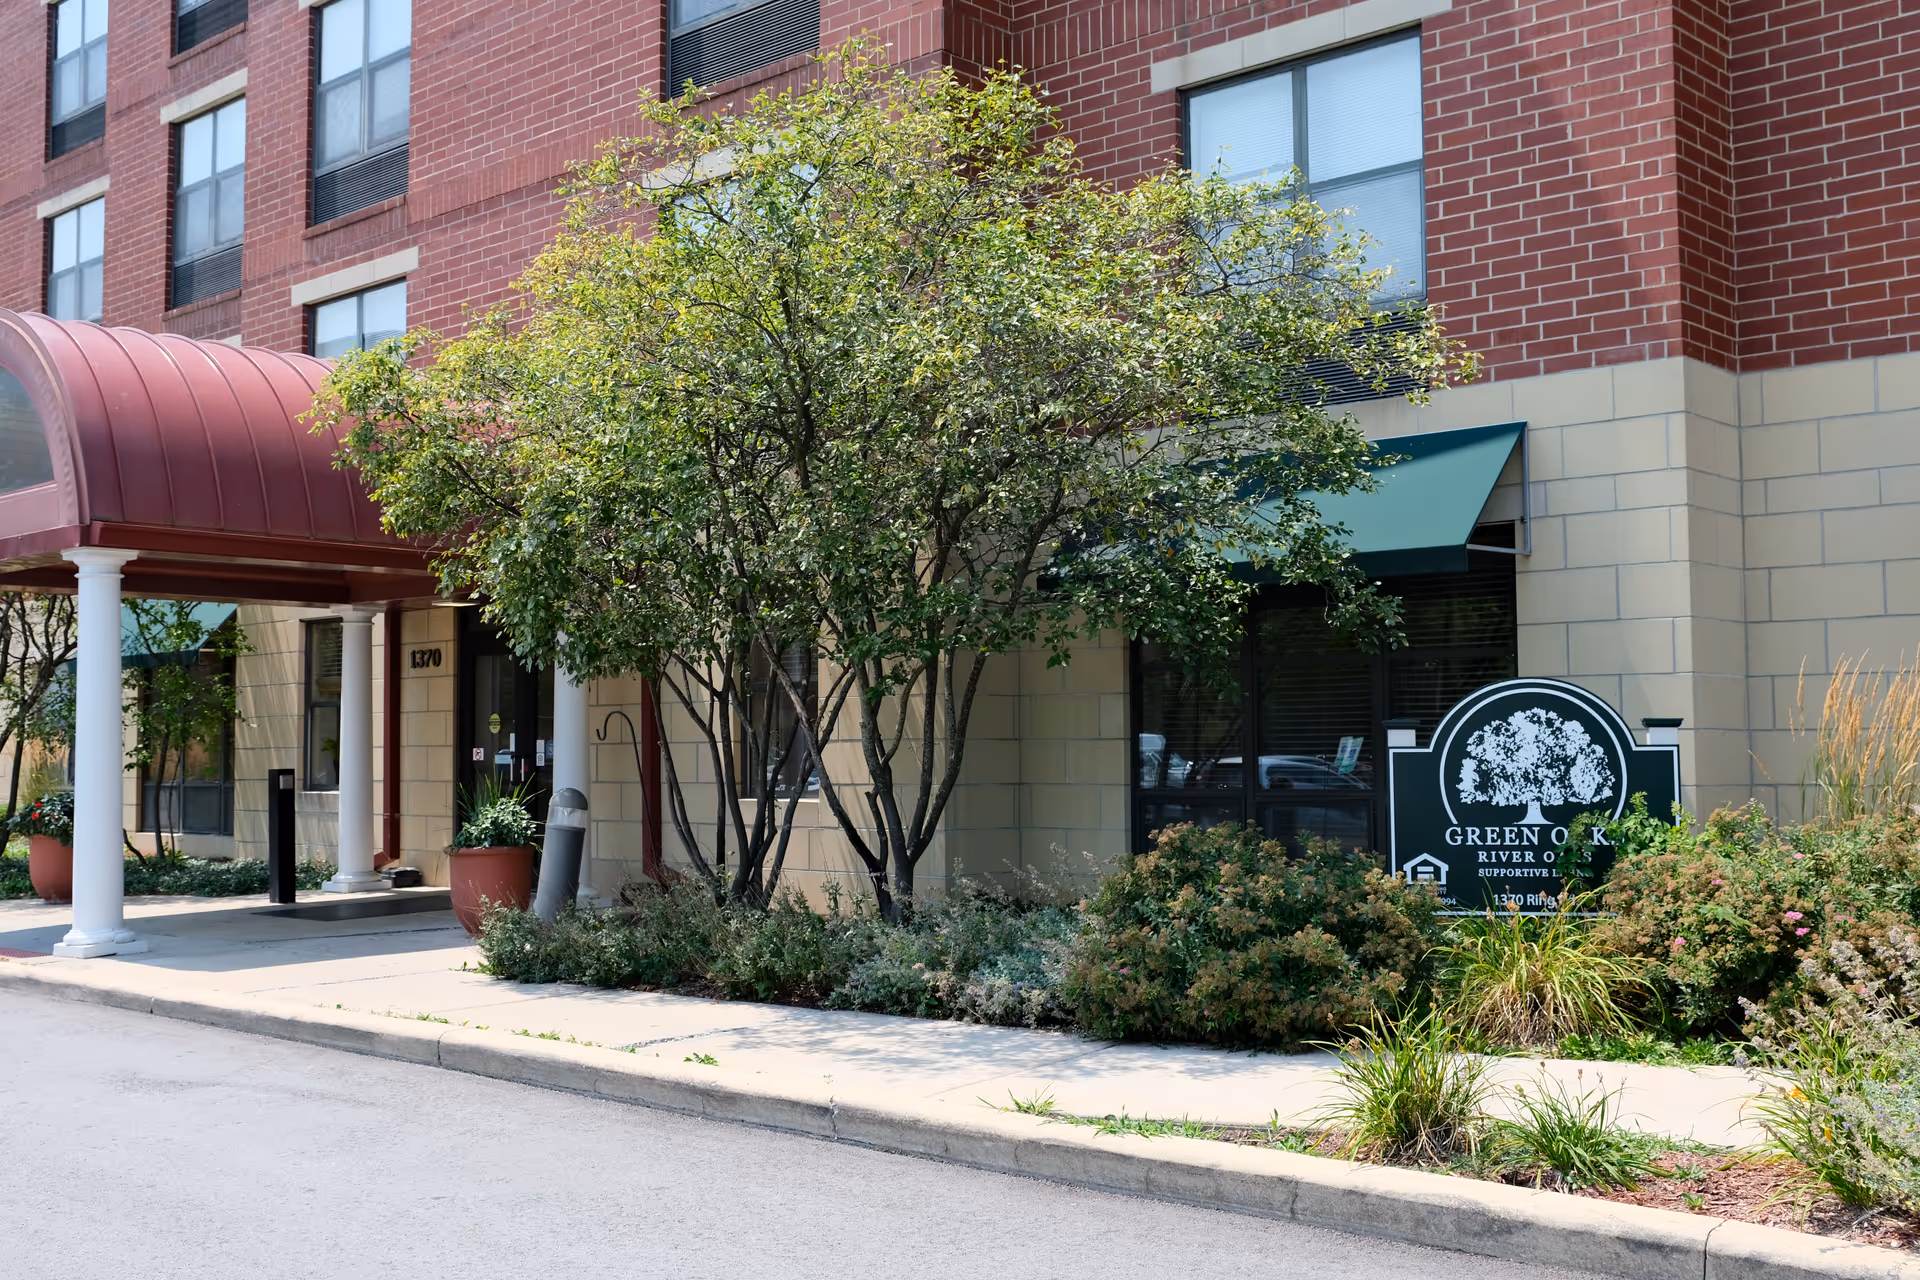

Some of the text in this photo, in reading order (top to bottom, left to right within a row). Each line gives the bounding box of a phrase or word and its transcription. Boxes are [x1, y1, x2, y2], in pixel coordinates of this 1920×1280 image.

[410, 648, 442, 669] 1370
[1445, 826, 1624, 846] GREEN OK
[1477, 850, 1592, 863] RIVER OS
[1478, 868, 1549, 877] SUPPORTIVE
[1493, 893, 1524, 906] 1370
[1526, 894, 1556, 909] Ring
